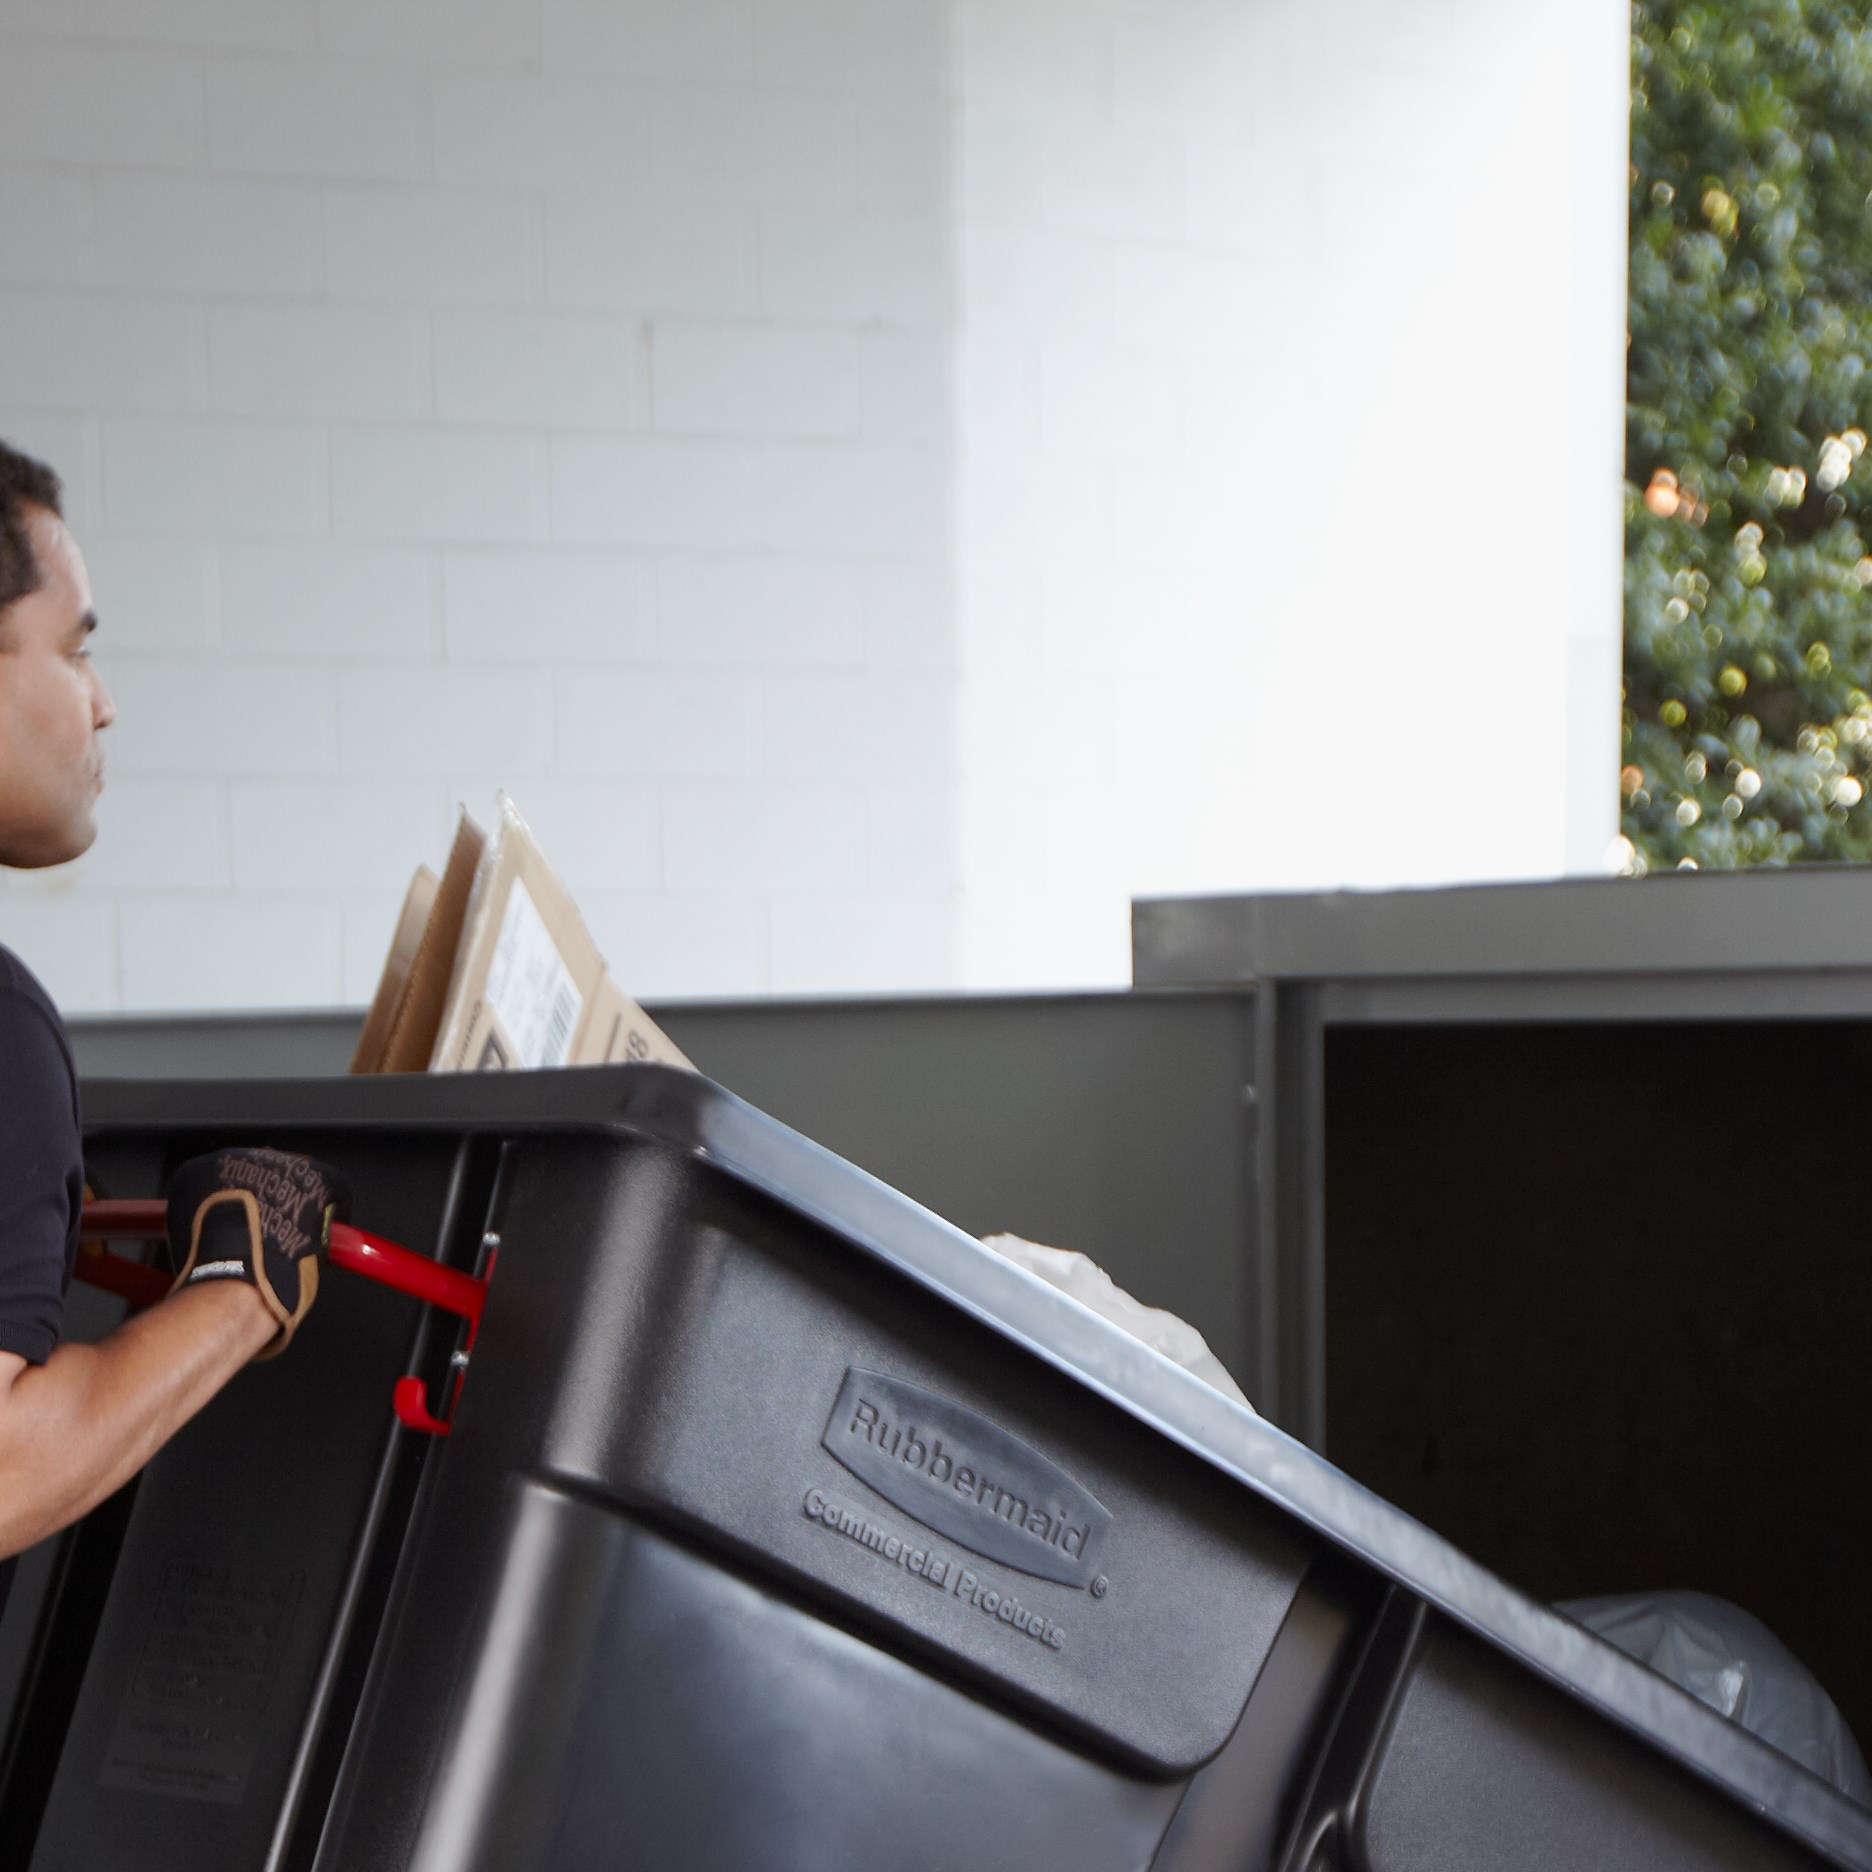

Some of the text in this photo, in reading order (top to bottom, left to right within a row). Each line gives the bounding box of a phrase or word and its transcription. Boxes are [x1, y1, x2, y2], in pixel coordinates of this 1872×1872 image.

[259, 1202, 312, 1258] Mech
[847, 1397, 1092, 1561] Rubbermaid
[802, 1487, 1067, 1652] Commercial Products
